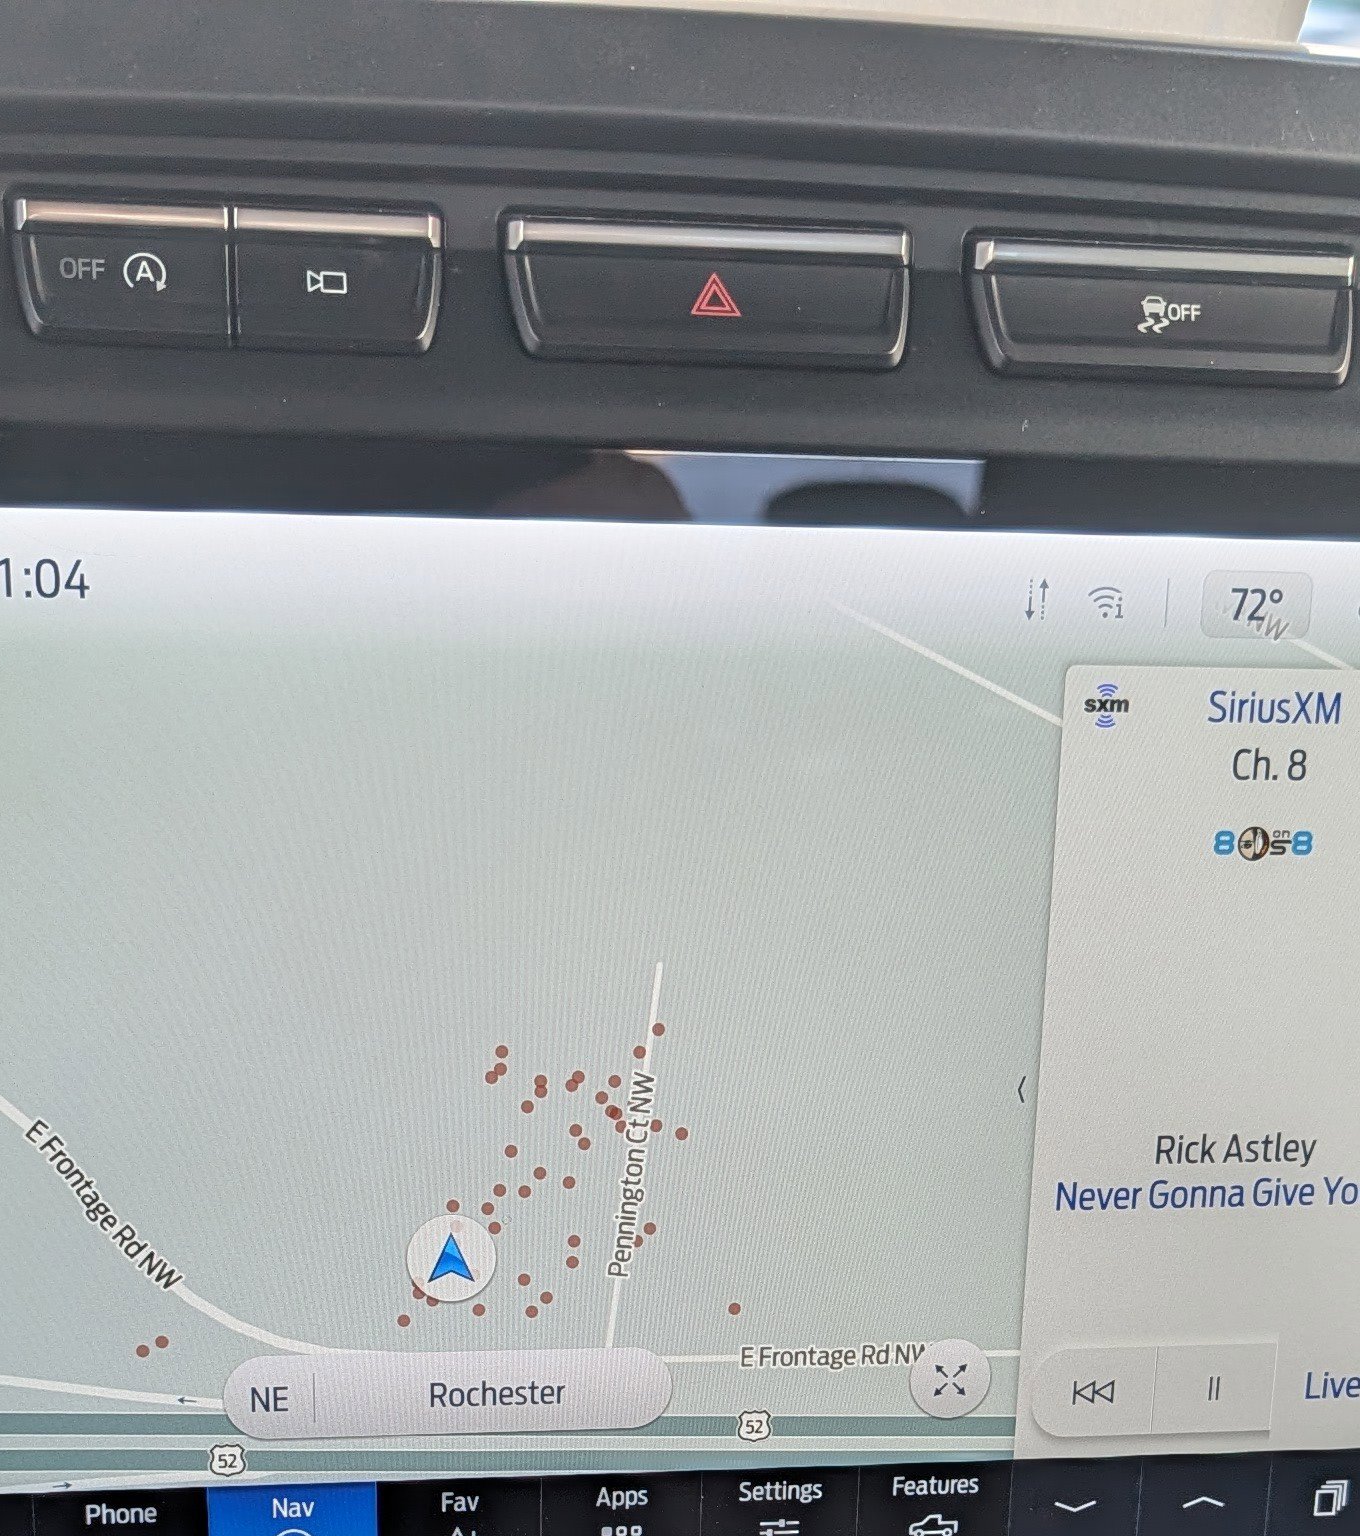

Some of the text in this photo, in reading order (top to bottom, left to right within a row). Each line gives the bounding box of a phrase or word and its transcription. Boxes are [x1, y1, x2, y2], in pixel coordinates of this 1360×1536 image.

[59, 257, 105, 280] OFF
[1167, 303, 1201, 321] OFF
[1083, 696, 1130, 714] sxm
[1207, 690, 1342, 726] SiriusXM
[1232, 748, 1308, 782] Ch. 8
[1292, 830, 1313, 856] 8
[1154, 1132, 1317, 1168] Rick Astley
[607, 1071, 655, 1277] Pennington Ct NW
[25, 1119, 184, 1290] E Frontage Rd NW
[1055, 1181, 1142, 1212] Never
[1148, 1179, 1245, 1210] Gonna
[1252, 1177, 1315, 1208] Give
[740, 1346, 755, 1367] E
[759, 1345, 856, 1370] Frontage
[861, 1344, 890, 1366] Rd
[249, 1385, 290, 1413] NE
[429, 1380, 566, 1408] Rochester
[745, 1419, 764, 1434] 52
[217, 1452, 238, 1469] 52
[596, 1484, 649, 1511] Apps
[738, 1479, 824, 1506] Settings
[892, 1473, 980, 1496] Features
[85, 1504, 158, 1526] Phone
[272, 1498, 314, 1519] Nav
[441, 1492, 480, 1513] Fav
